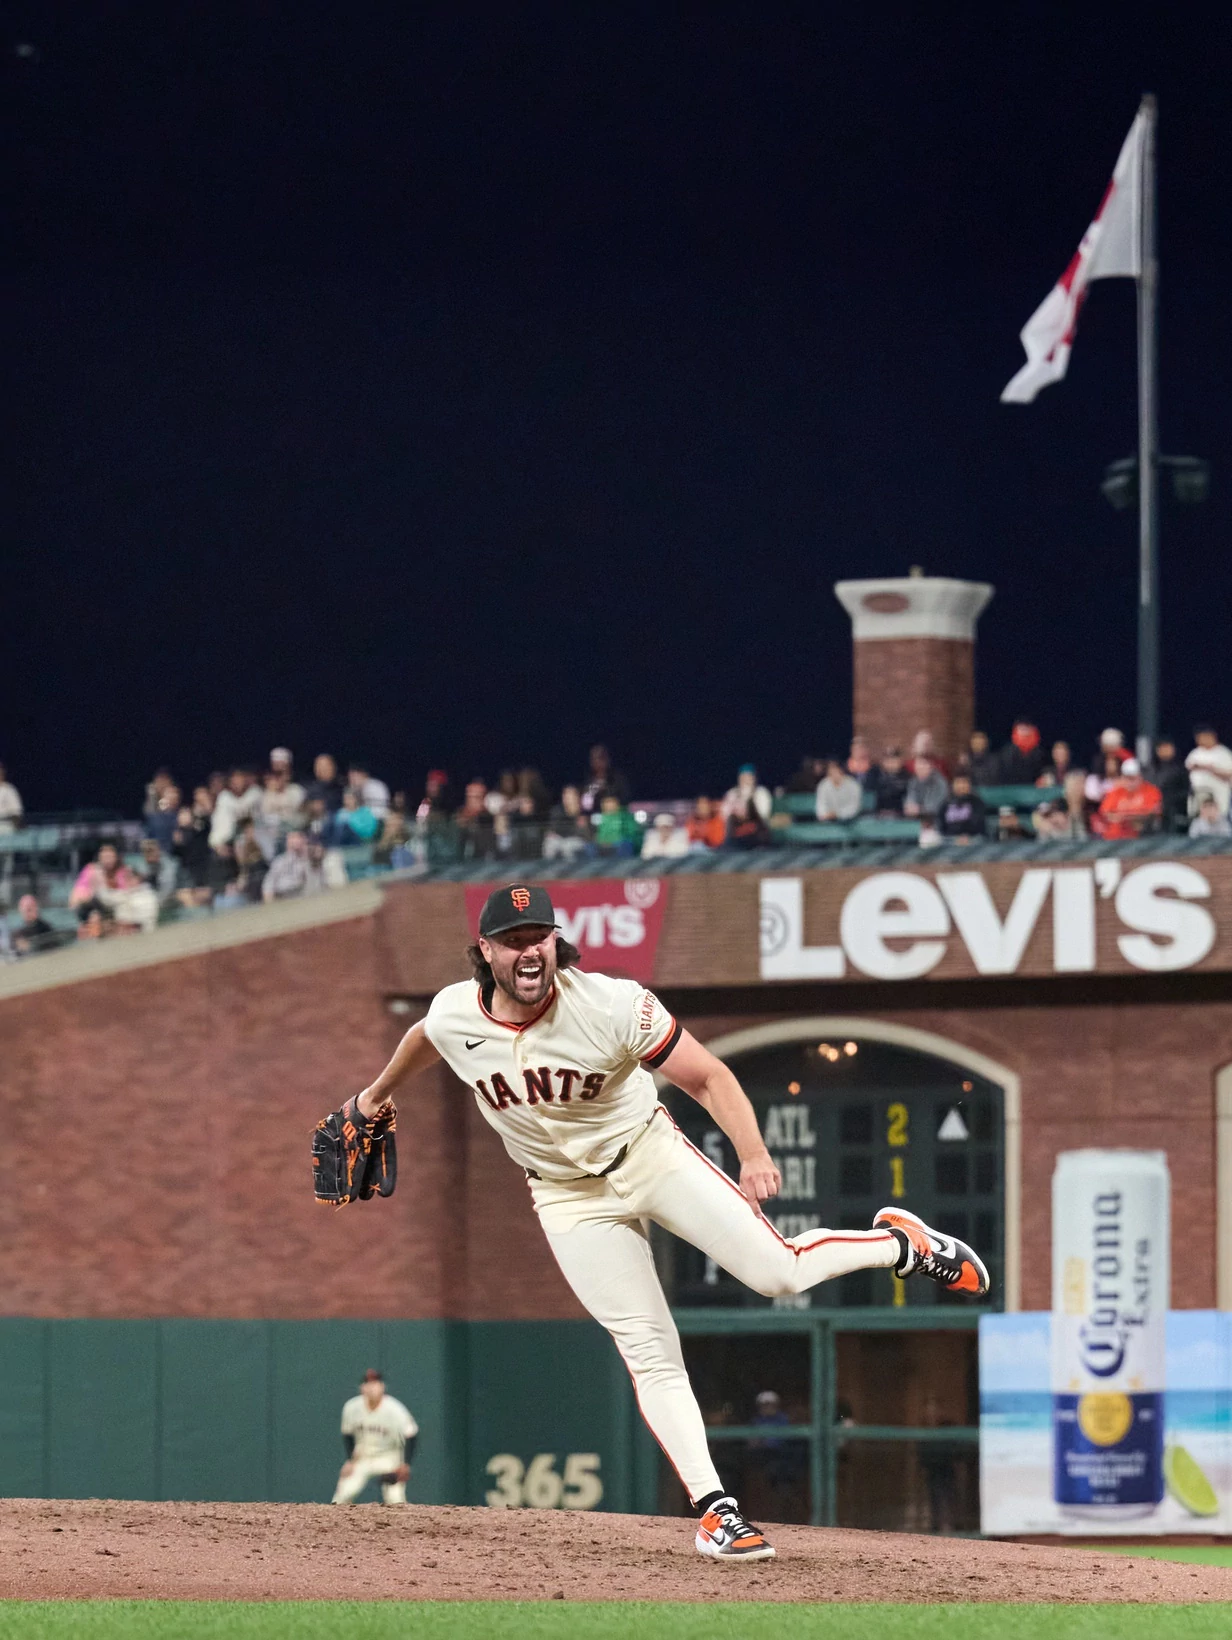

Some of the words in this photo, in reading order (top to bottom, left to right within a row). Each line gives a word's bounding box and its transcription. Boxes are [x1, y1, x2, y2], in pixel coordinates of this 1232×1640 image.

[640, 991, 656, 1031] GIANTS
[476, 1066, 607, 1111] IANTS
[765, 1103, 817, 1148] ATL
[887, 1103, 908, 1147] 2
[889, 1157, 905, 1197] 1
[1081, 1190, 1126, 1377] Corona
[1121, 1238, 1149, 1328] Extra
[485, 1453, 603, 1509] 365
